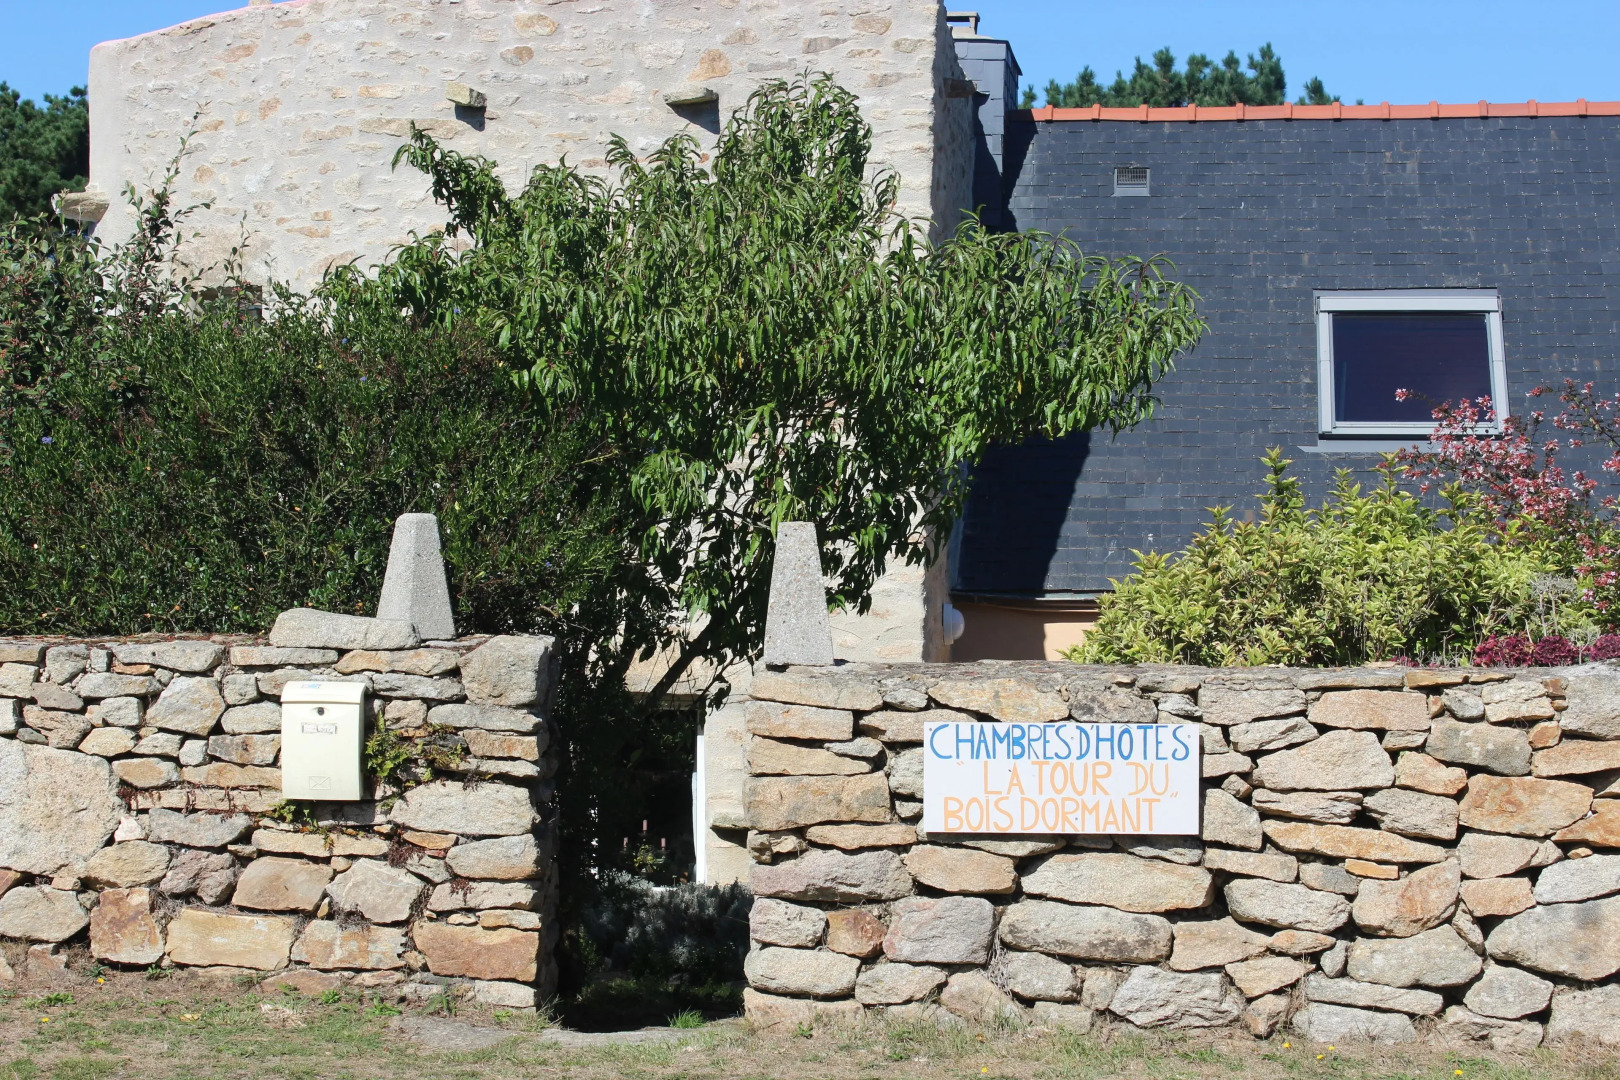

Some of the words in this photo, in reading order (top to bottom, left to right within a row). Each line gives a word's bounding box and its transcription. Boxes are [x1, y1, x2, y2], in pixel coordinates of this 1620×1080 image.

[929, 723, 1072, 761] CHAMBRES
[1076, 724, 1190, 761] D'HÔTES
[1031, 760, 1113, 797] TOUR
[943, 796, 1014, 832] BOIS
[1020, 796, 1161, 833] DORMANT
